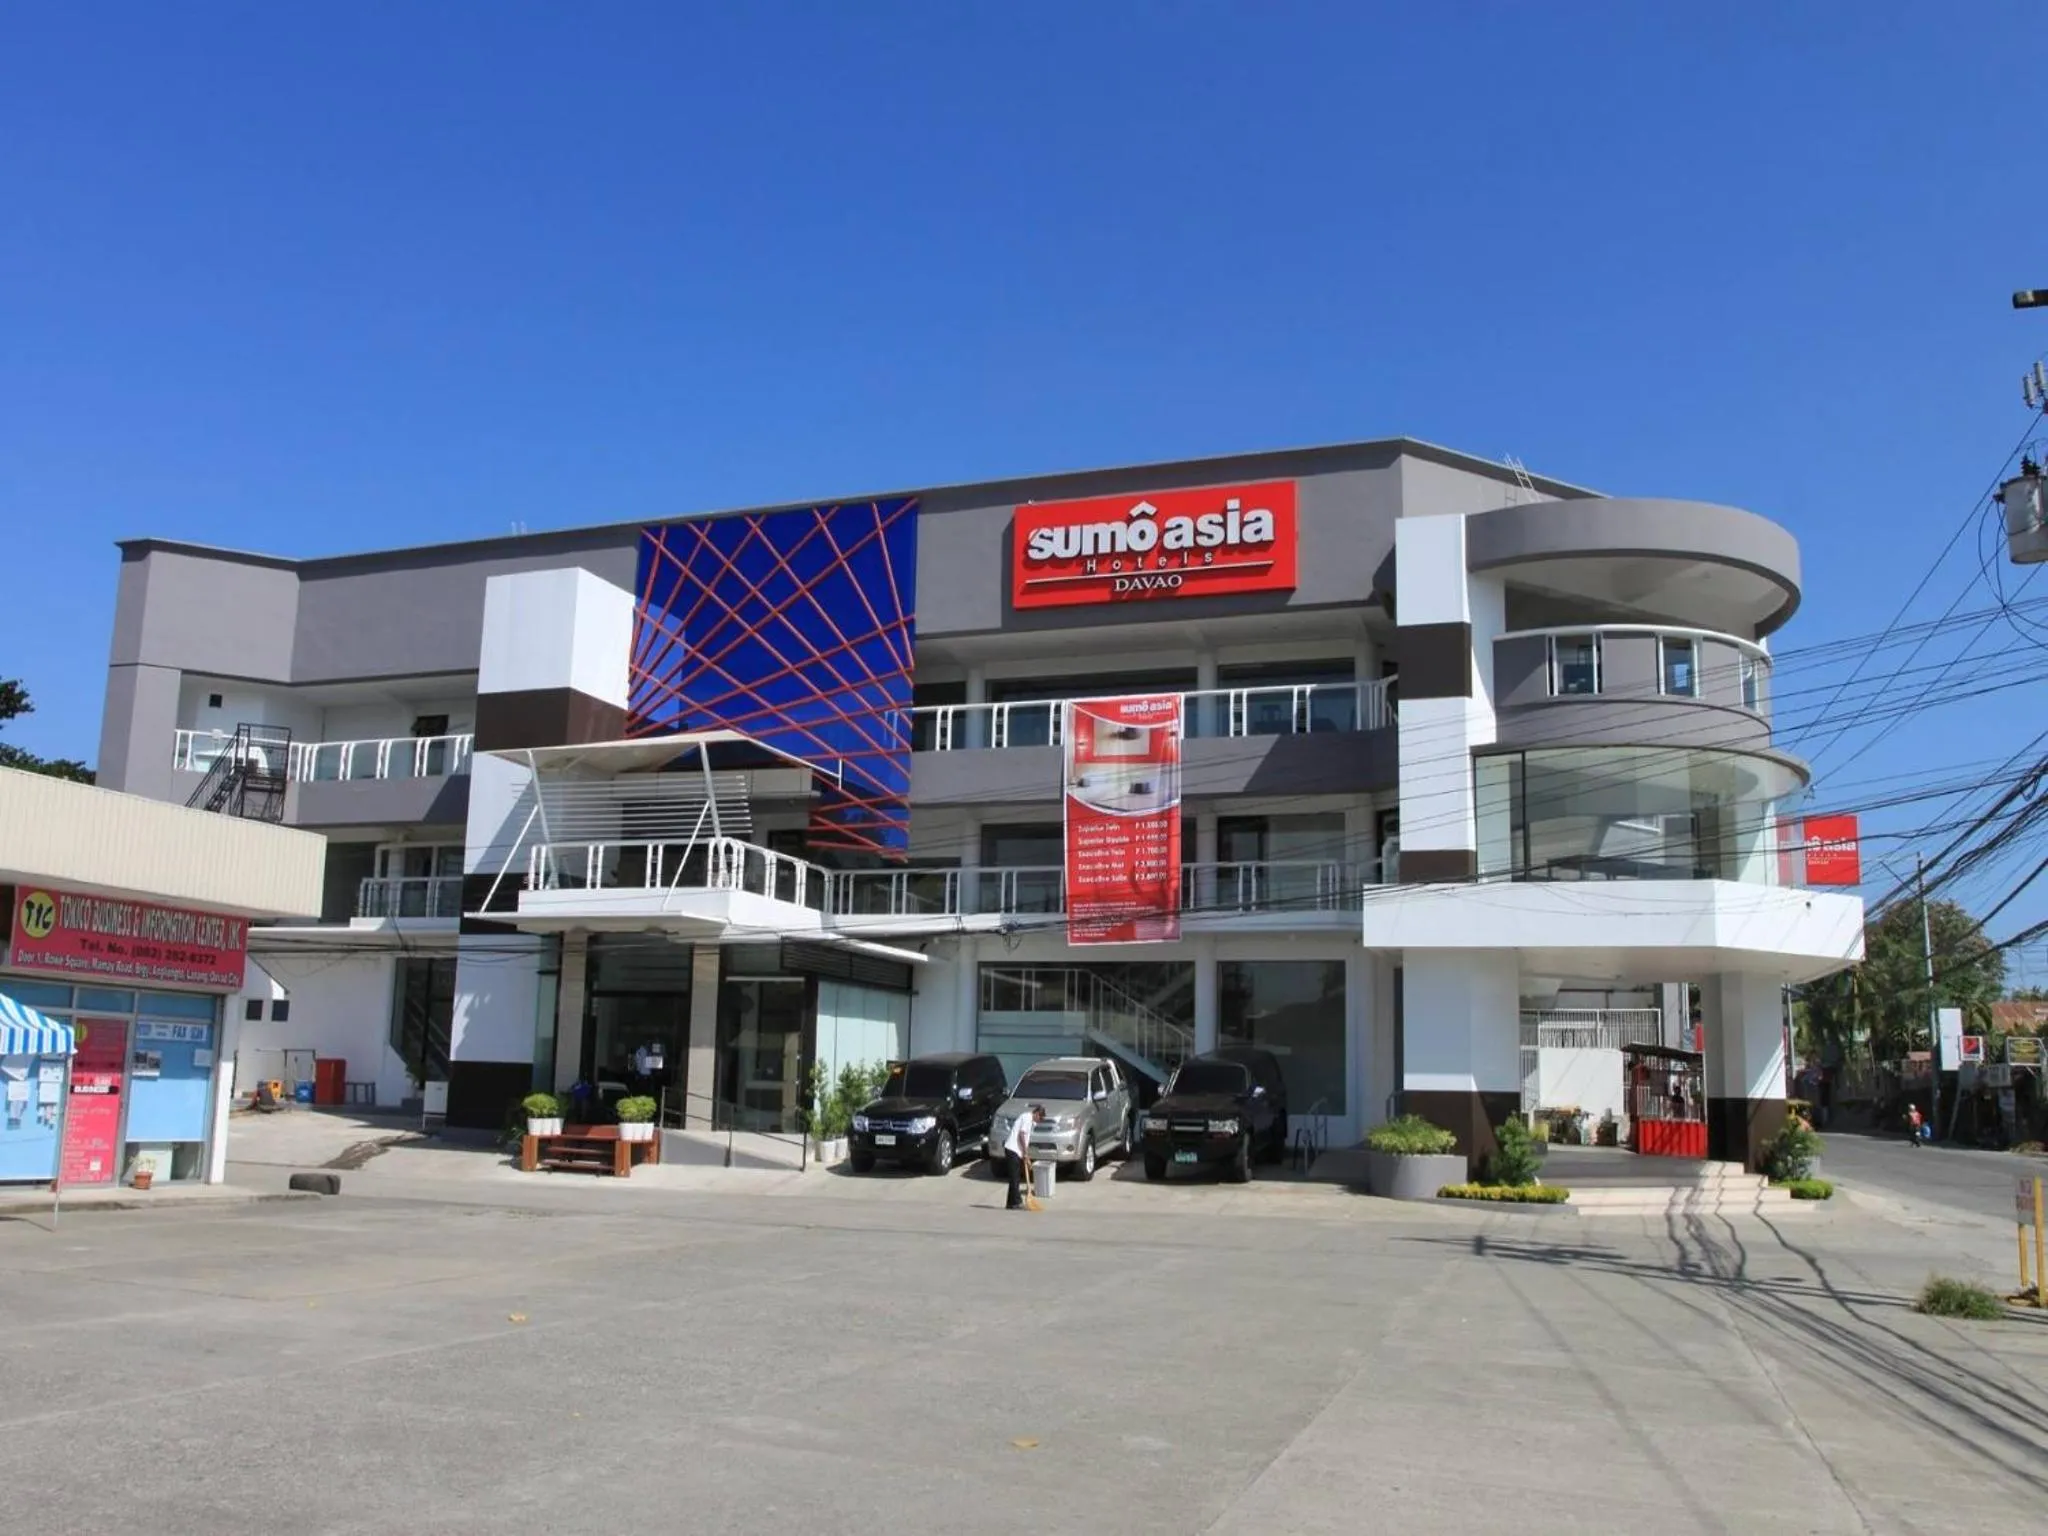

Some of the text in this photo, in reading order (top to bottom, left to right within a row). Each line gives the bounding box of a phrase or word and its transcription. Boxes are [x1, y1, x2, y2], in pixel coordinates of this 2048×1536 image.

[1028, 498, 1274, 560] sumô asia
[1086, 552, 1213, 572] Hotels
[1114, 574, 1183, 592] DAVAO
[92, 900, 133, 938] BUSINESS
[141, 907, 196, 945] INFORMATION
[80, 938, 104, 952] Tel.
[171, 1024, 188, 1038] FAX
